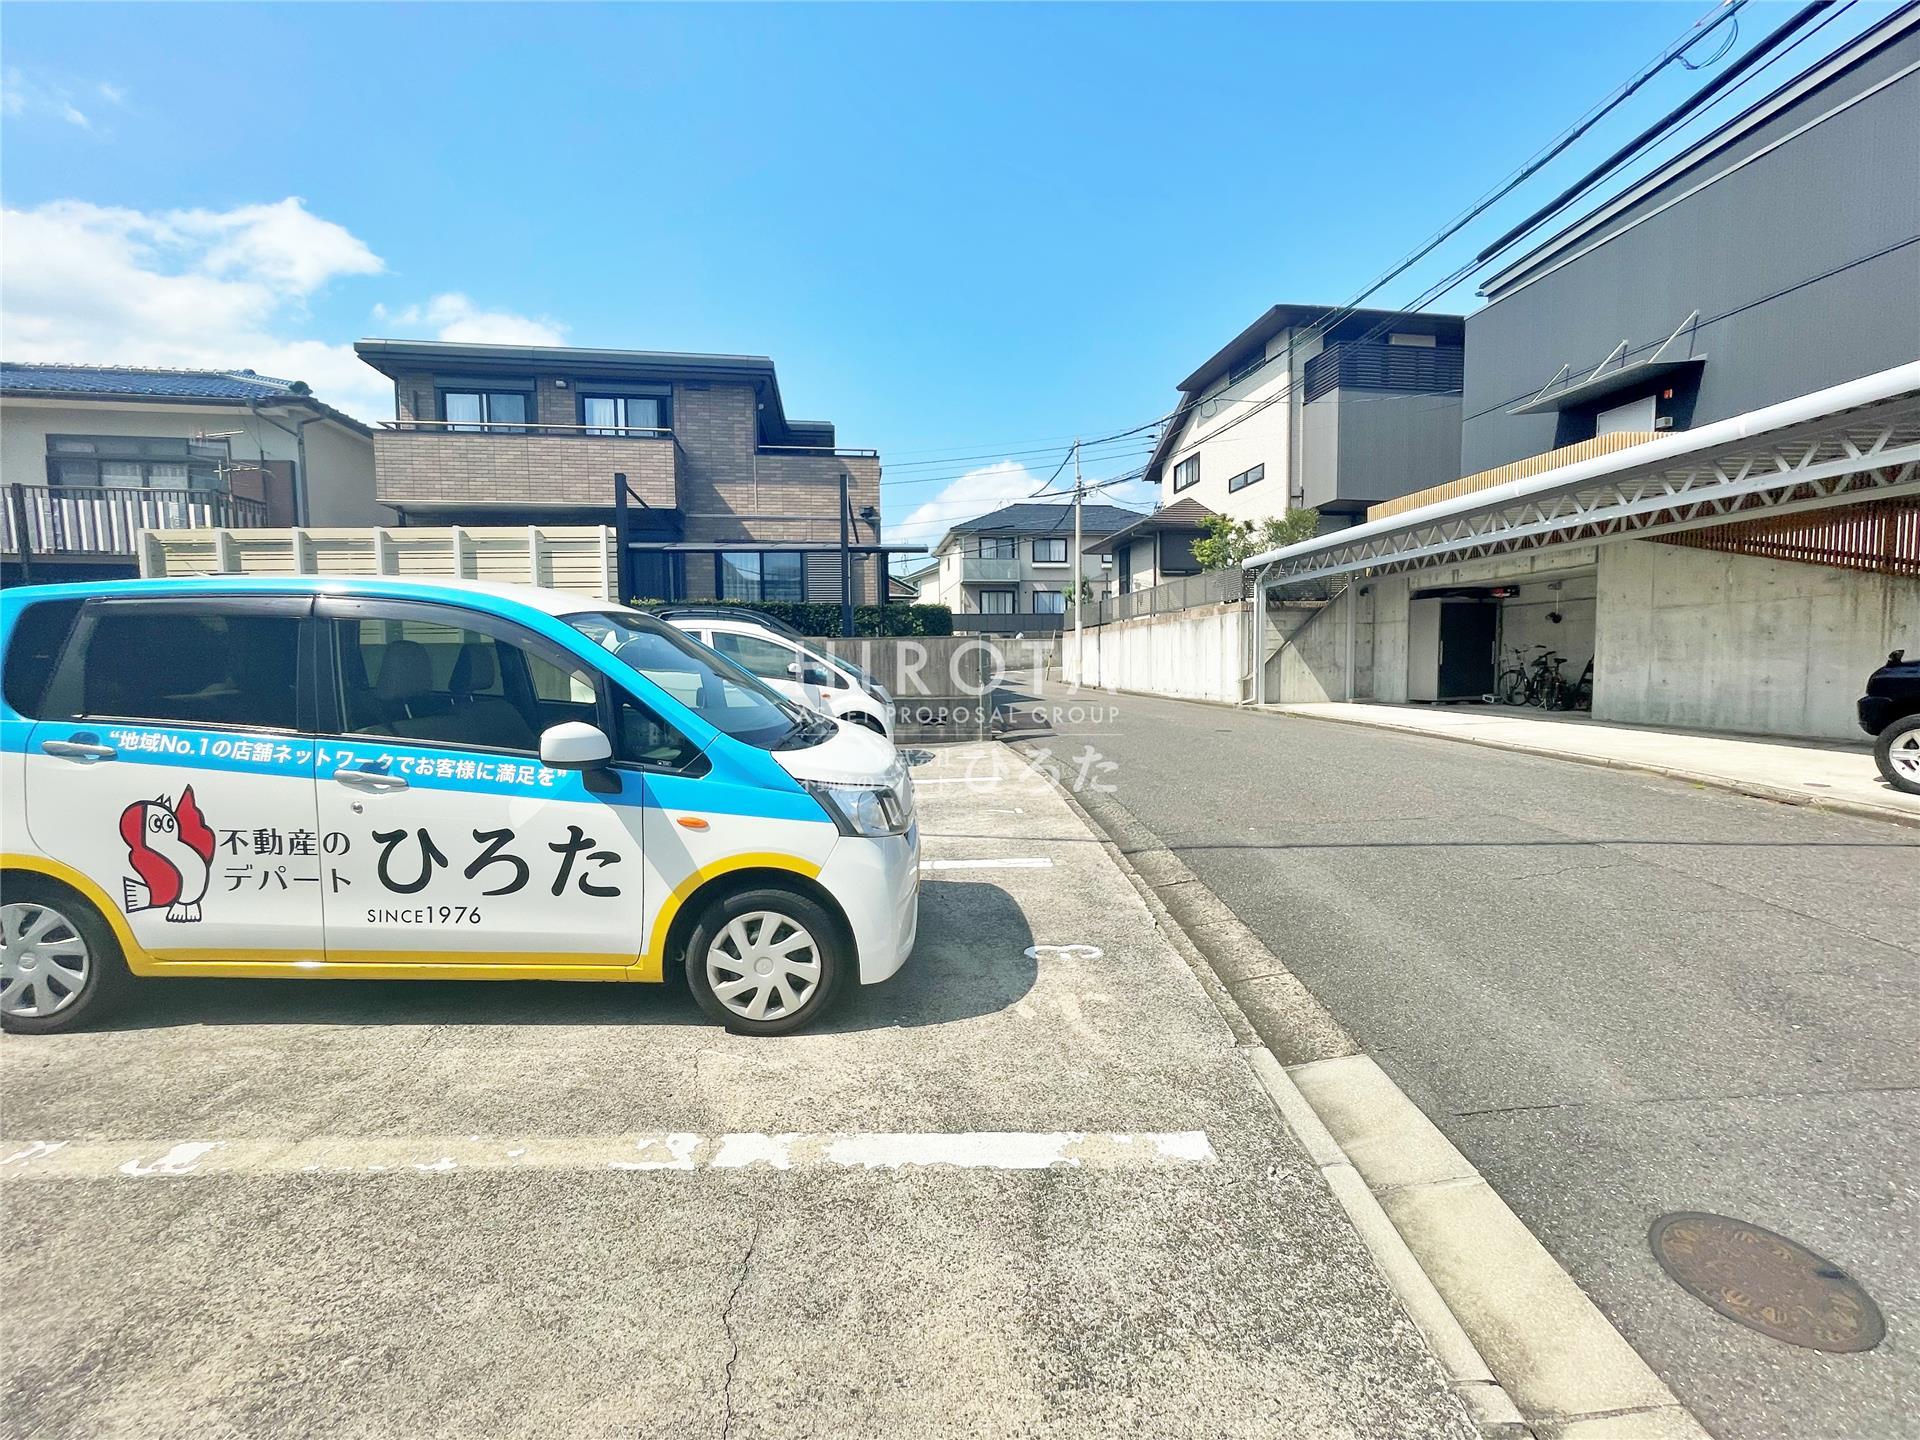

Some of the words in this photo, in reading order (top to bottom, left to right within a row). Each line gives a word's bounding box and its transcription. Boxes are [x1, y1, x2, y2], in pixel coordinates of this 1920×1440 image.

[218, 827, 351, 857] 不動産の
[371, 824, 622, 897] ひろた
[224, 863, 353, 894] デパート
